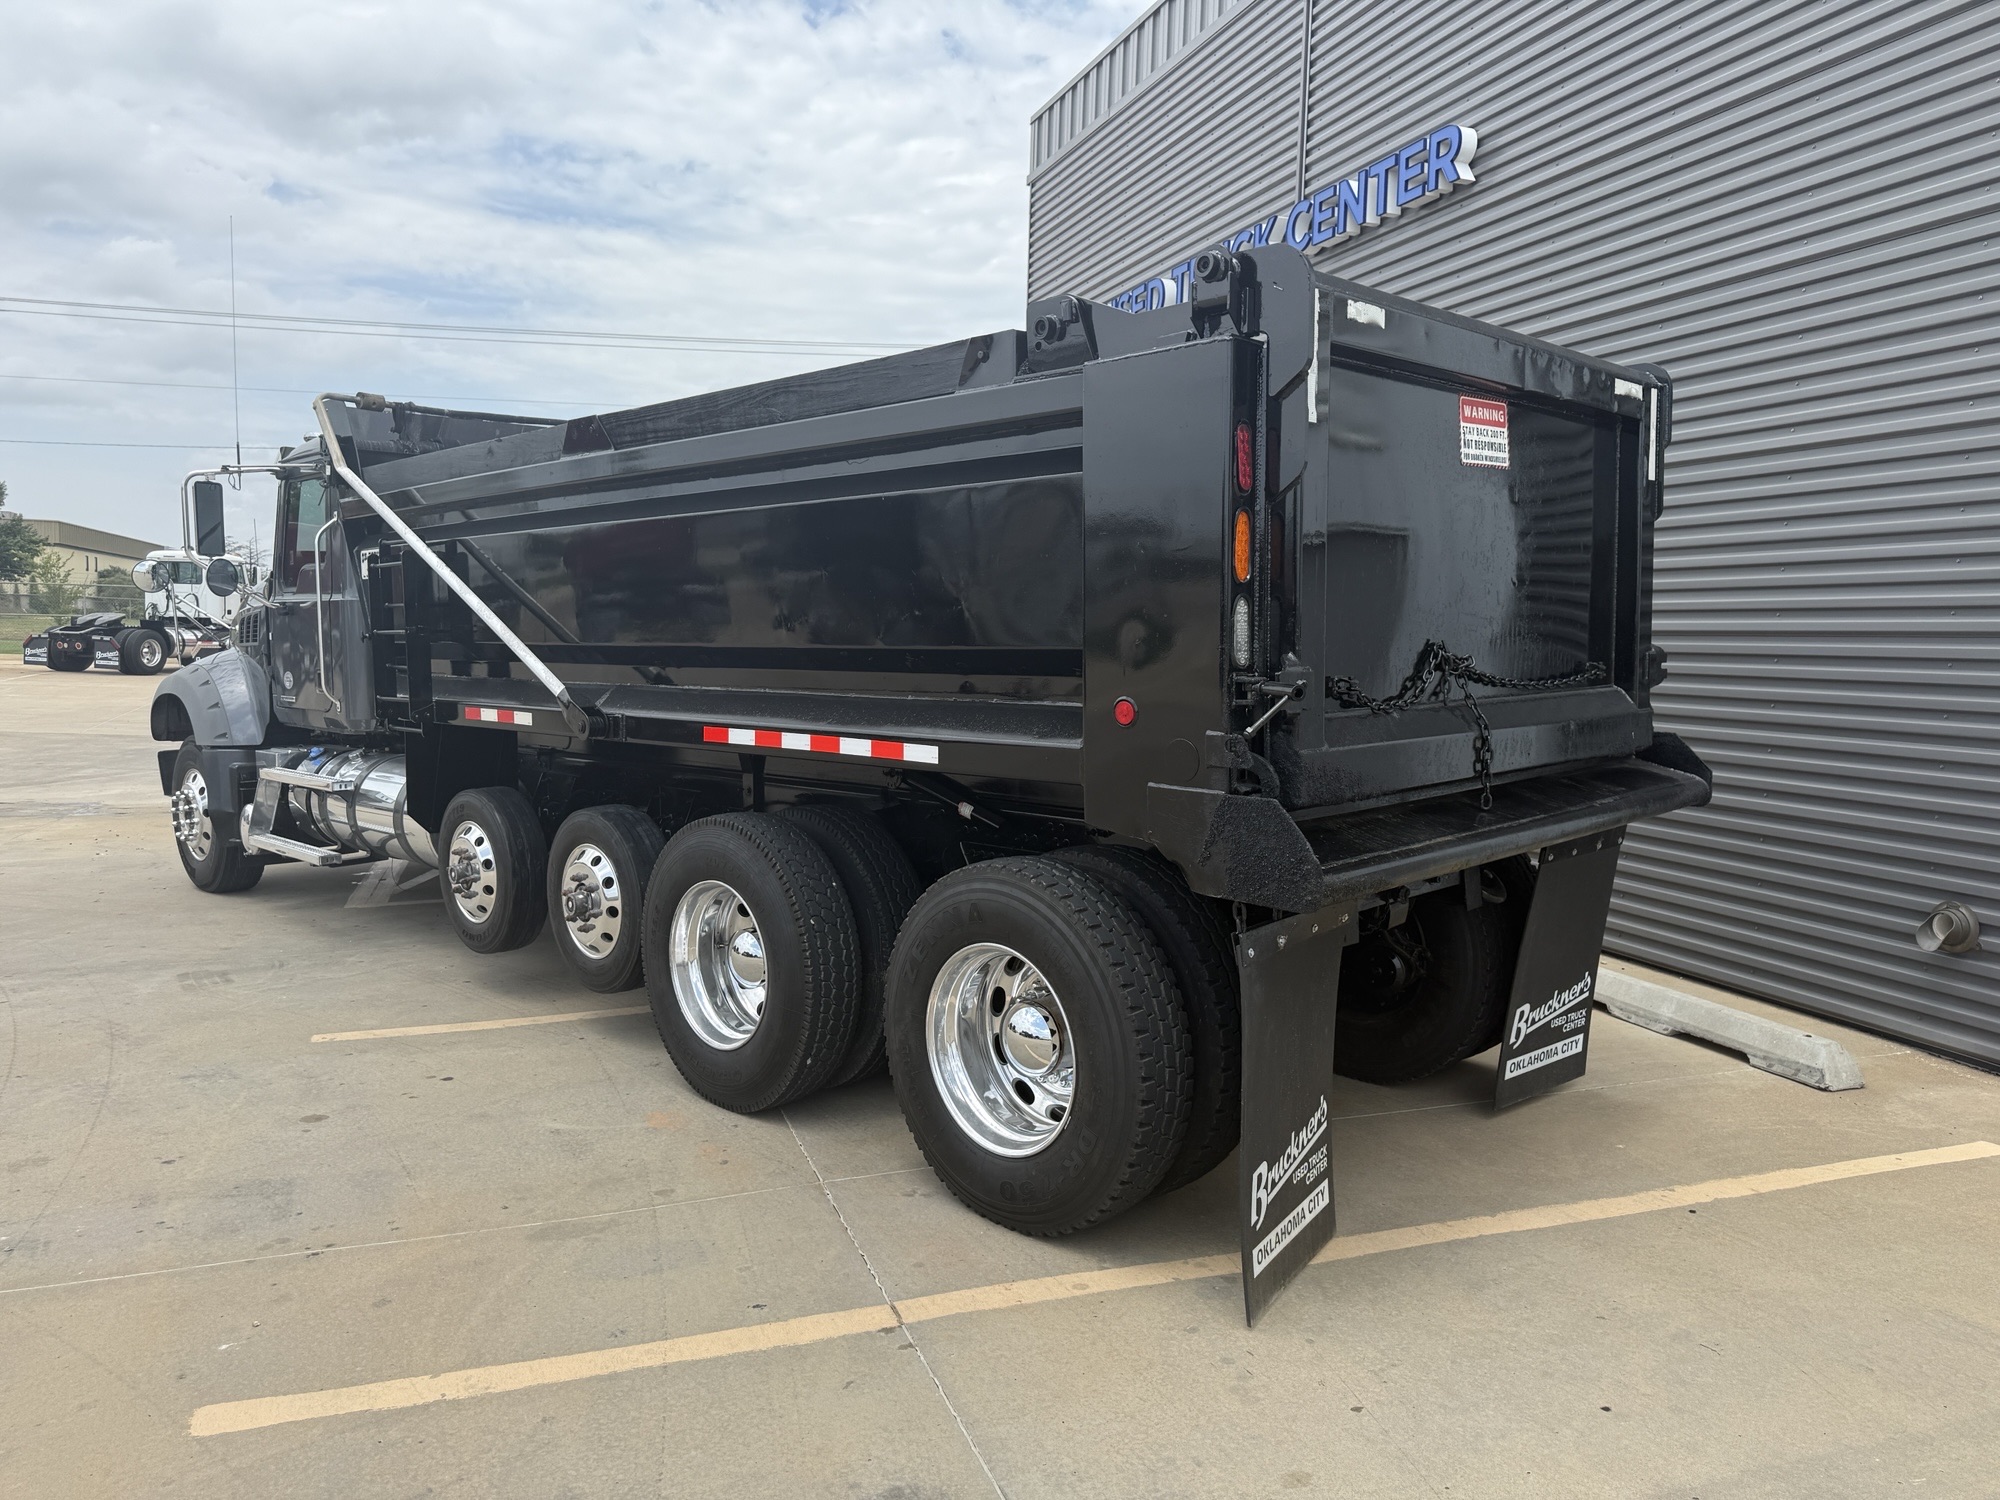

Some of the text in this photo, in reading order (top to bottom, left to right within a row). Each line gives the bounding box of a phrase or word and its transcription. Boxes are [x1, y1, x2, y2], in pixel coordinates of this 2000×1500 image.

[1286, 123, 1474, 254] CENTER
[1463, 404, 1504, 422] WARNING
[1462, 426, 1475, 436] STAY
[1476, 427, 1489, 437] BACK
[1463, 438, 1507, 453] NOT RESPONSIBLE
[1509, 971, 1592, 1050] Bruckner's
[1551, 1007, 1588, 1028] USED TRUCK
[1562, 1018, 1586, 1033] CENTER
[1509, 1038, 1581, 1074] OKLAHOMA CITY
[1251, 1094, 1328, 1232] Bruckner's
[1292, 1144, 1328, 1185] USED TRUCK
[1305, 1159, 1328, 1185] CENTER
[1256, 1185, 1326, 1266] OKLAHOMA CITY
